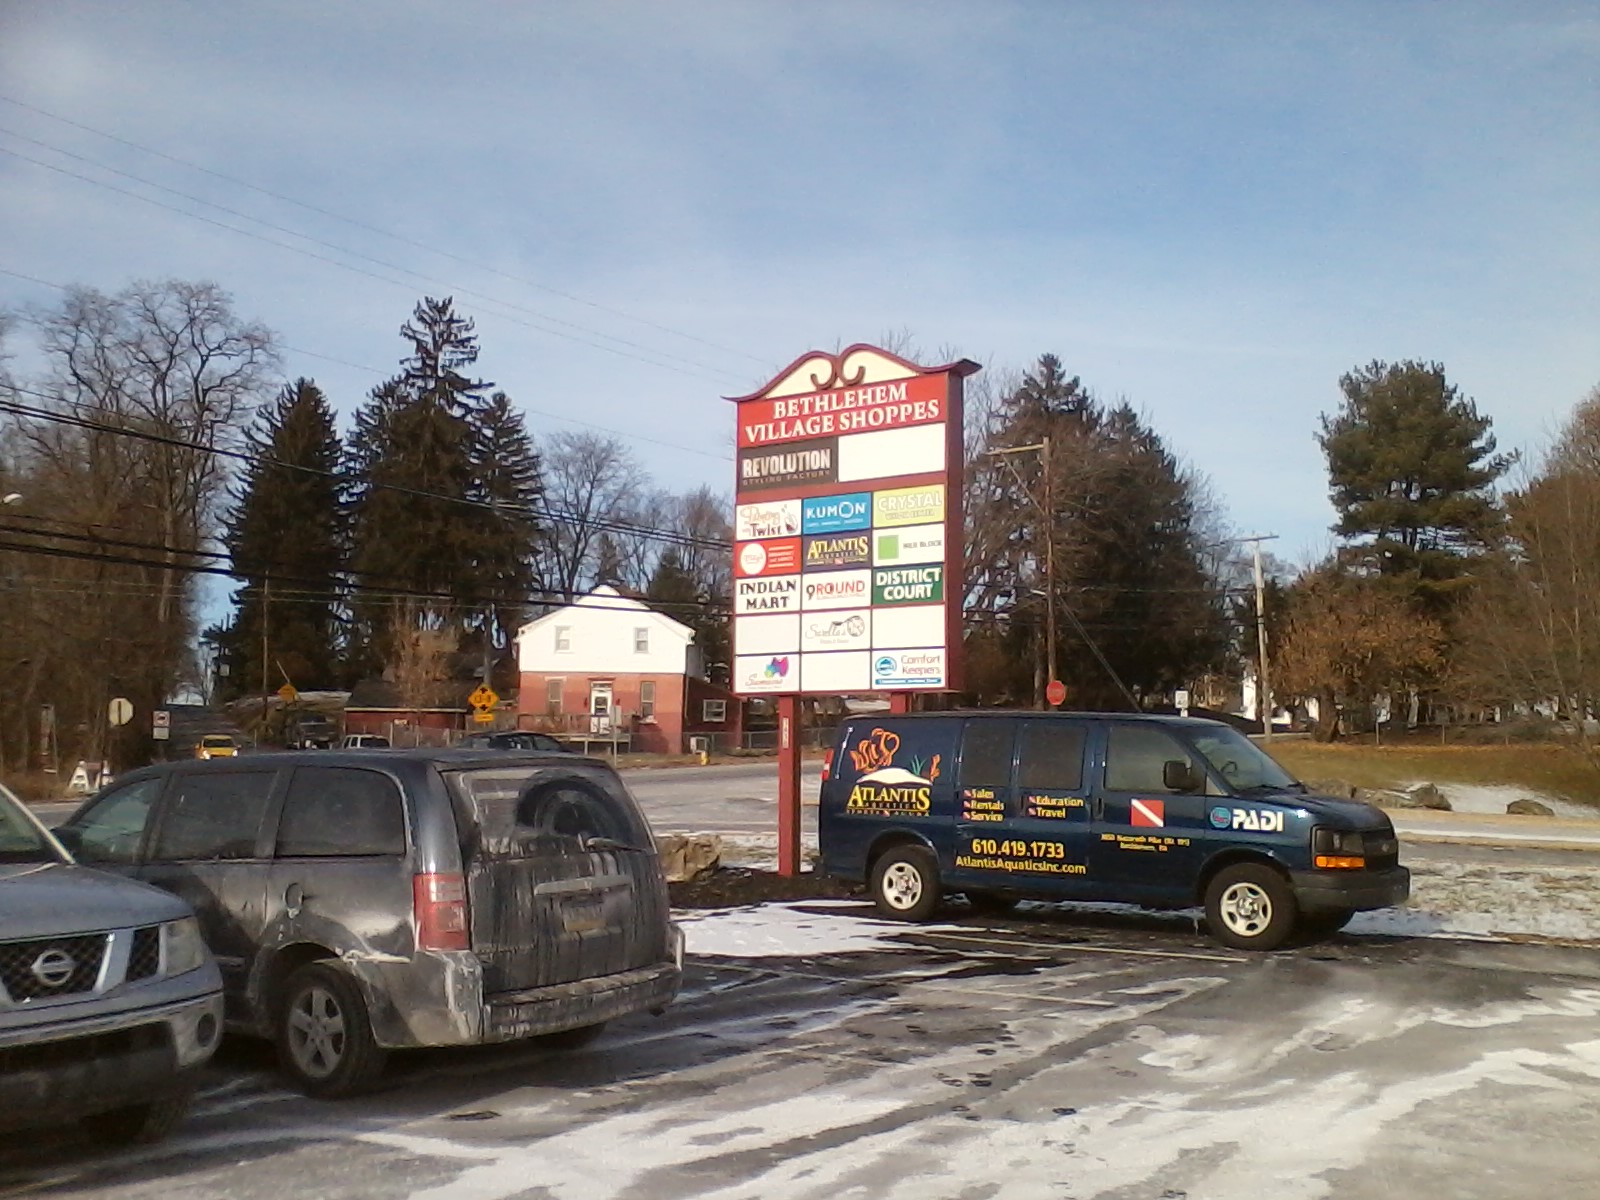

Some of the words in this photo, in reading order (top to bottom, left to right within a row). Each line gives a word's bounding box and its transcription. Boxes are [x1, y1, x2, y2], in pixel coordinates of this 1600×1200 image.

[774, 383, 908, 419] BETHLEHEM
[745, 414, 834, 443] VILLAGE
[839, 399, 940, 431] SHOPPES
[743, 448, 831, 478] REVOLUTION
[878, 492, 942, 511] CRYSTAL
[806, 502, 866, 519] KUMON
[808, 536, 868, 559] ATLANTIS
[876, 567, 941, 586] DISTRICT
[740, 579, 797, 595] INDIAN
[883, 583, 933, 600] COURT
[746, 596, 789, 611] MART
[901, 654, 940, 665] Comfort
[848, 785, 931, 811] ATLANTIS
[971, 788, 994, 800] Sales
[1036, 795, 1084, 807] Education
[971, 800, 1004, 811] Rentals
[1036, 807, 1066, 818] Travel
[970, 811, 1004, 822] Service
[1232, 808, 1284, 832] PADI
[972, 838, 1065, 859] 610.419.1733
